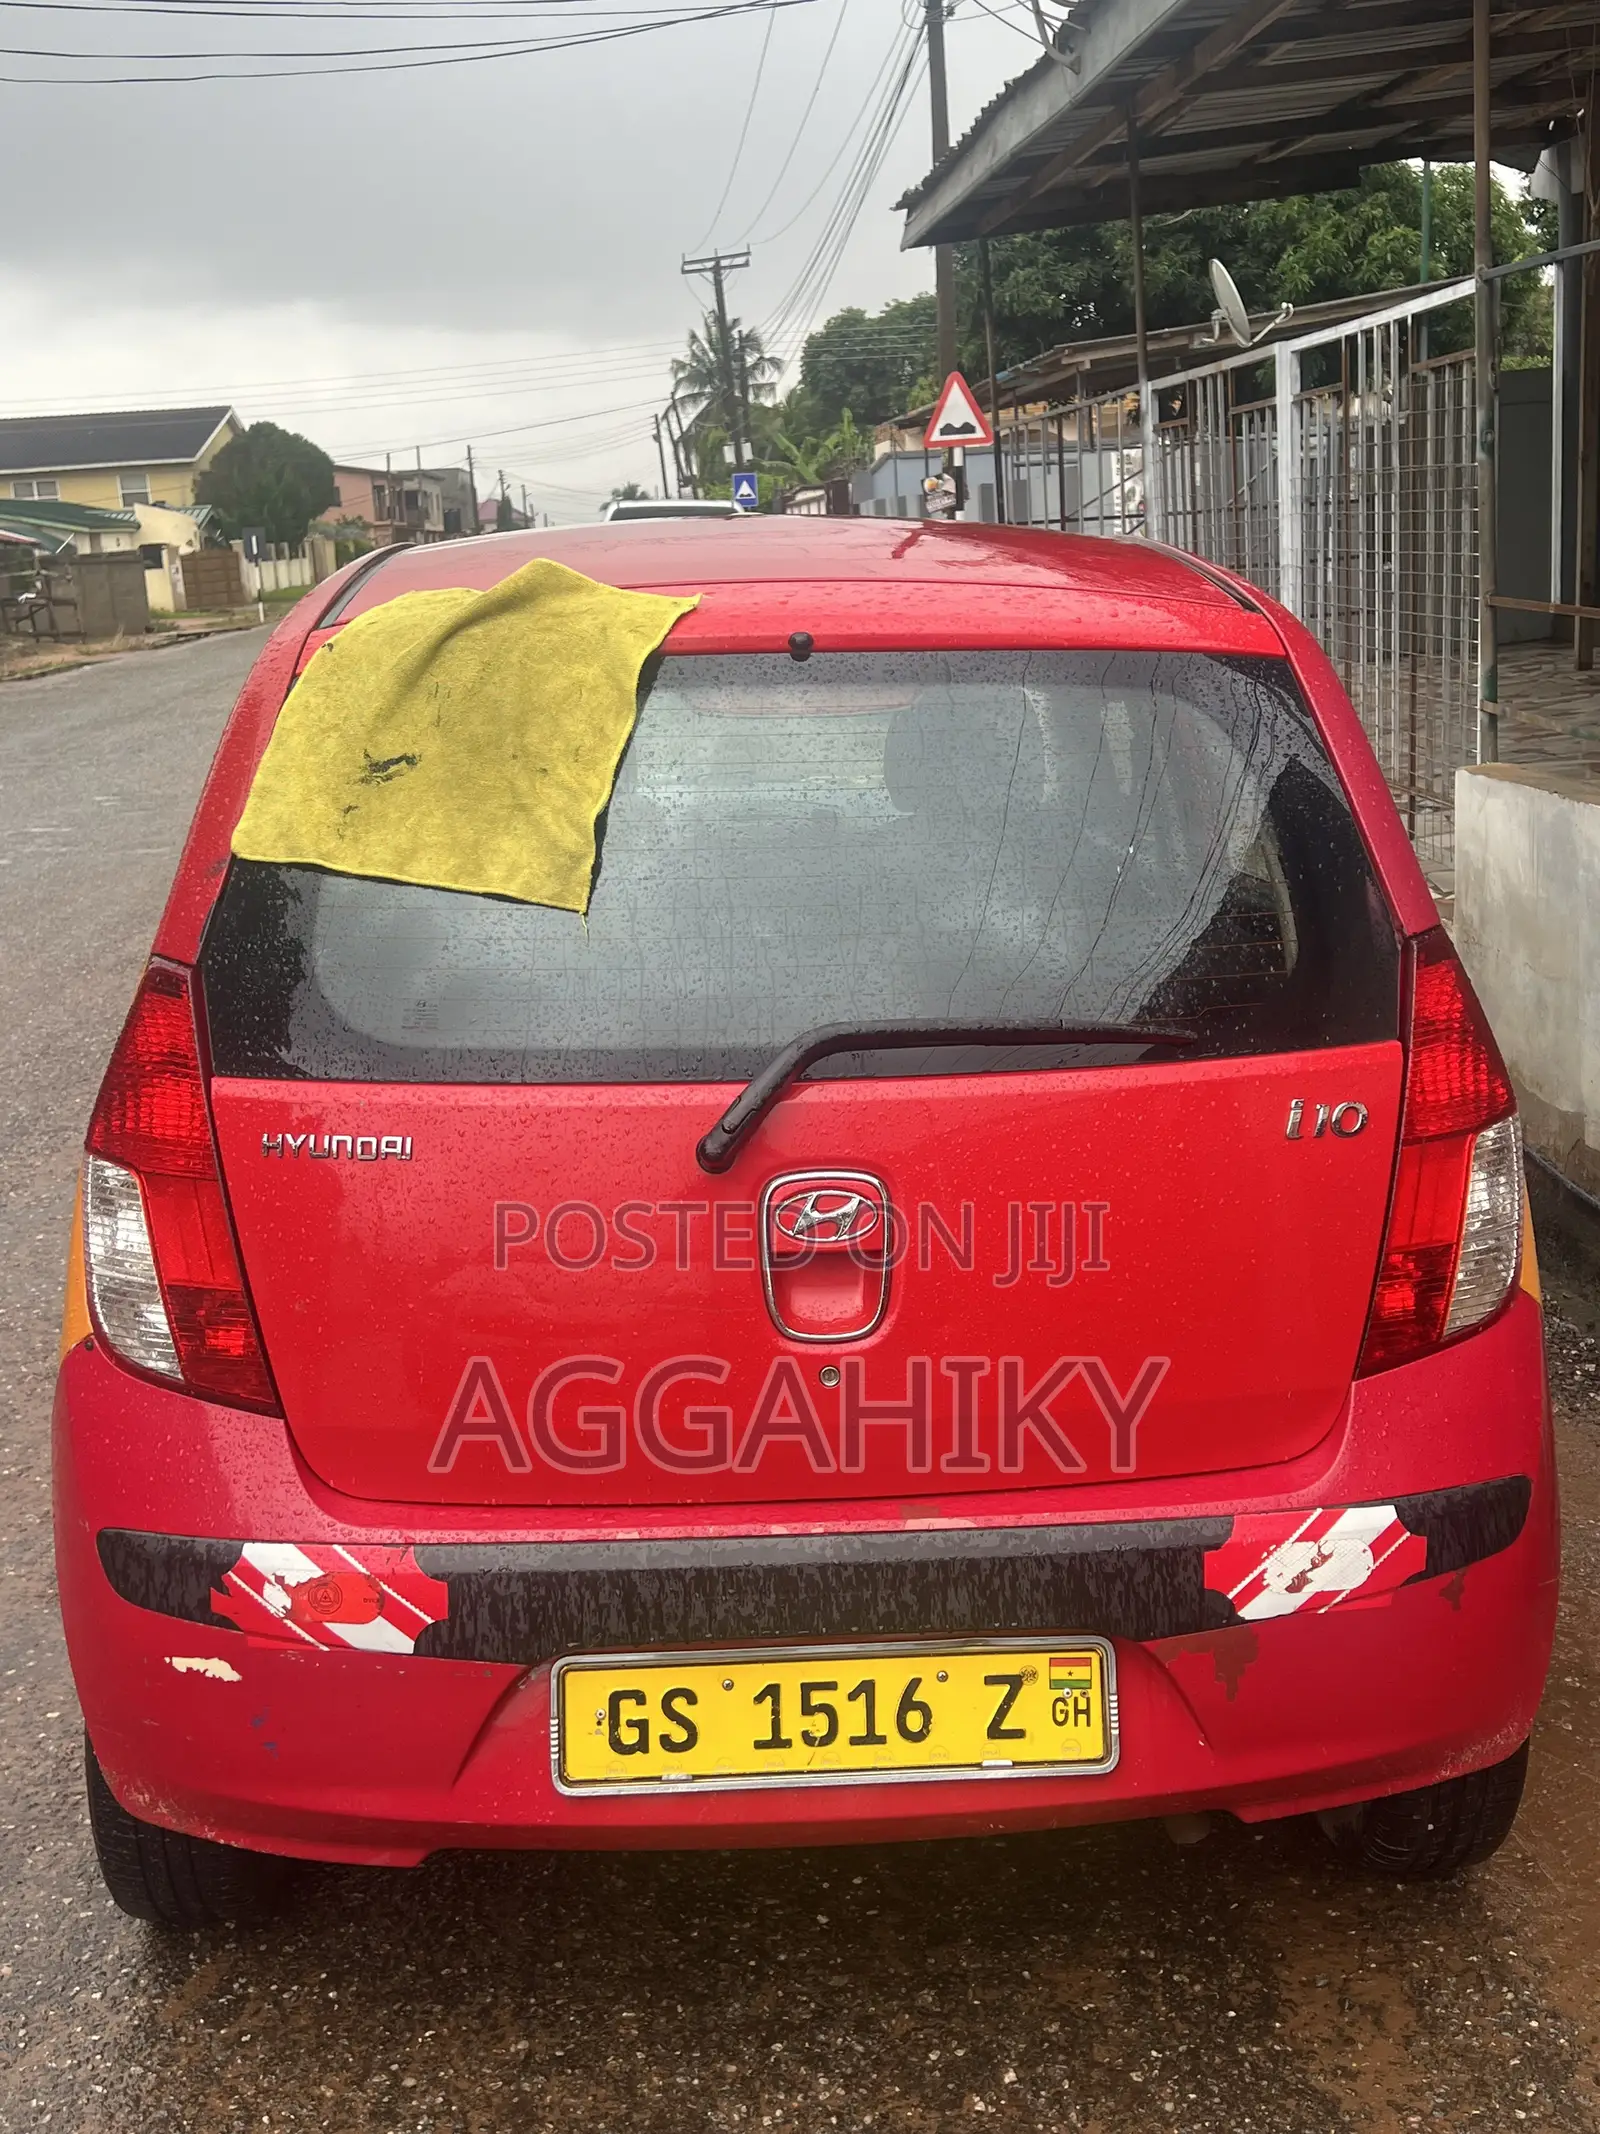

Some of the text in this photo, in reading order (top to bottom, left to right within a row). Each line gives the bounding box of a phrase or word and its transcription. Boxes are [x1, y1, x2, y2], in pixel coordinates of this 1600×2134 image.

[1285, 1098, 1369, 1140] i10
[261, 1133, 413, 1161] HYUNDAI
[608, 1674, 1027, 1755] GS 1516 Z
[1052, 1696, 1091, 1728] GH
